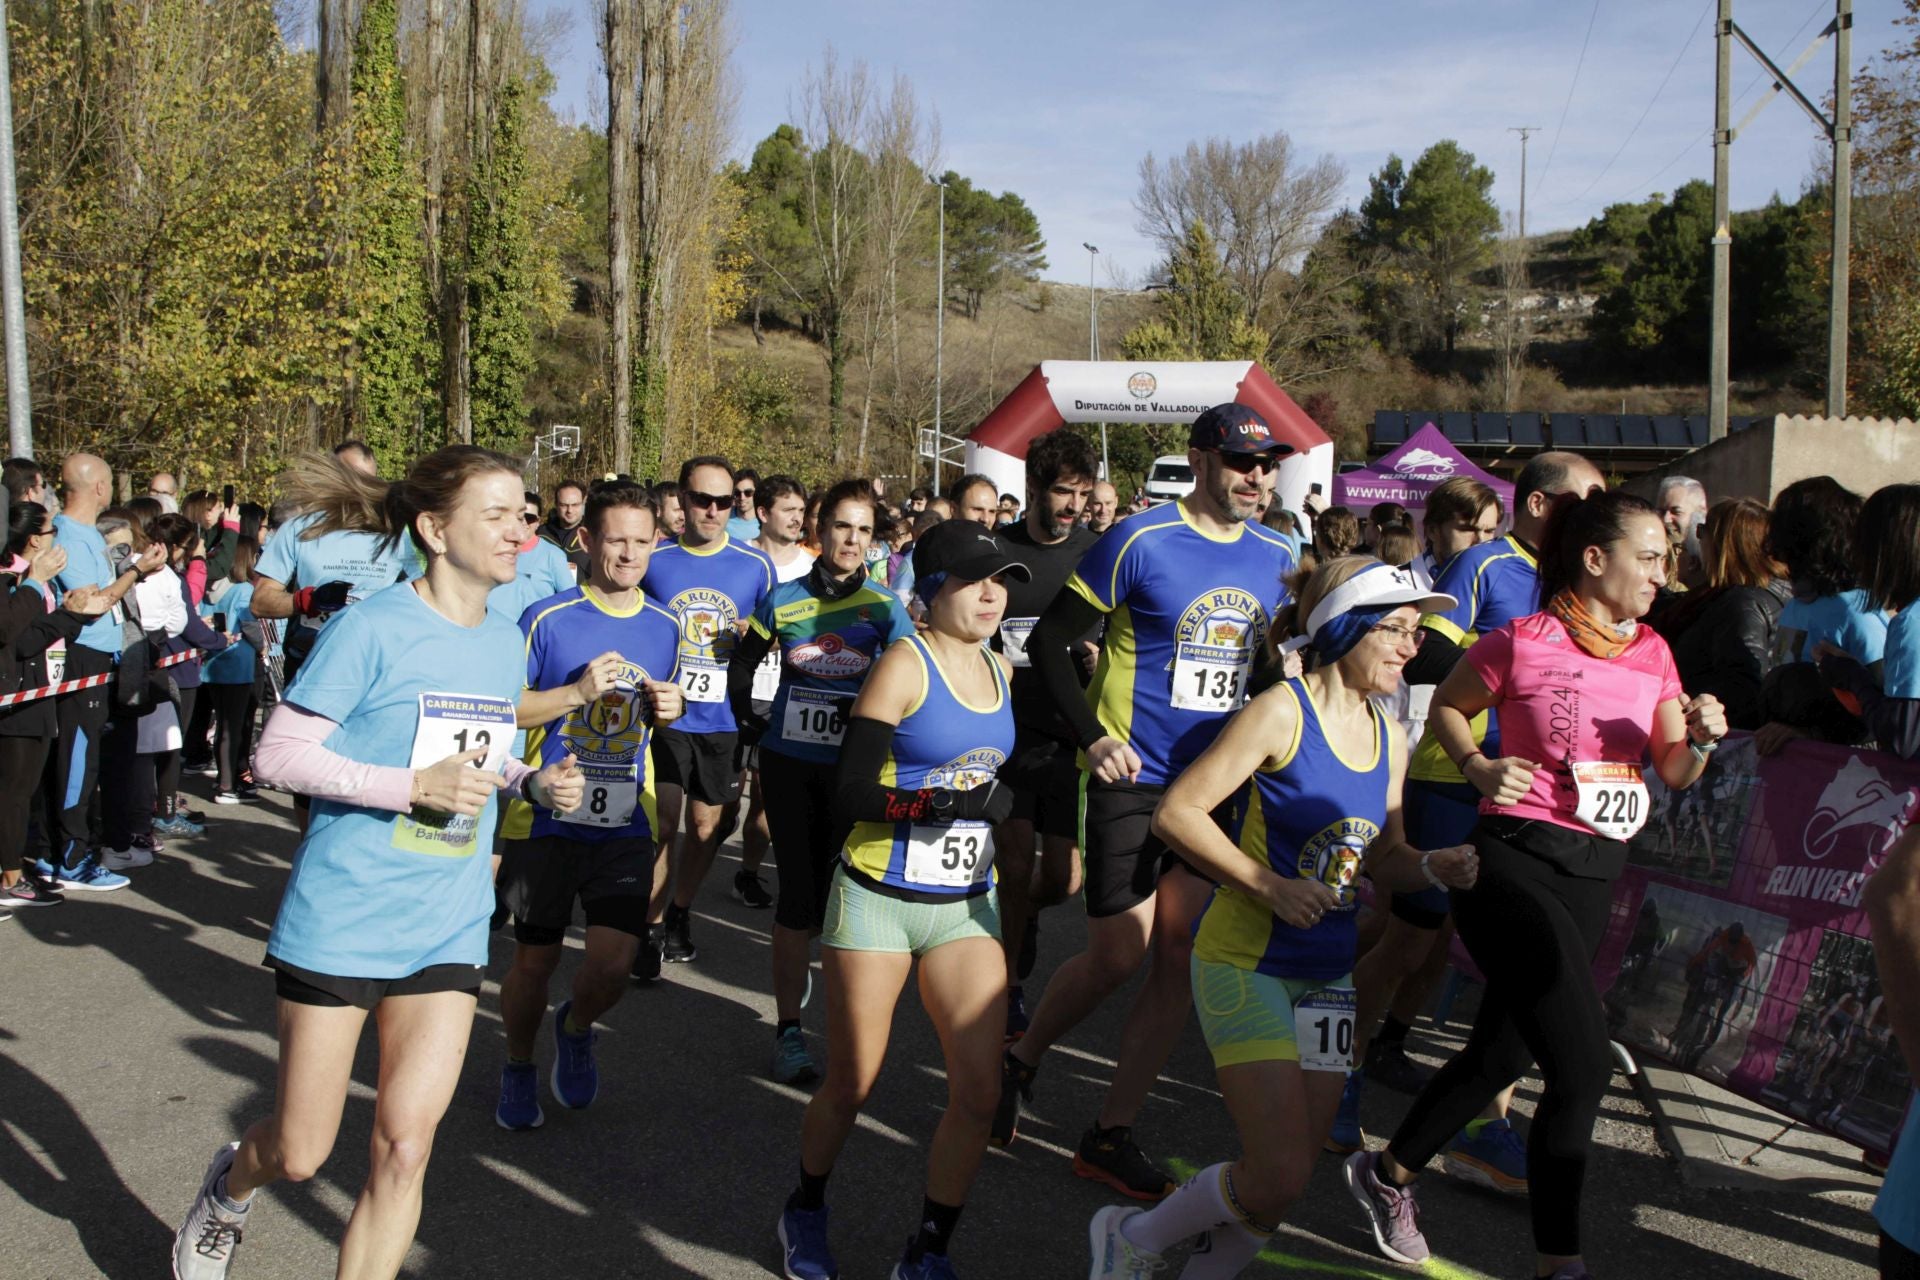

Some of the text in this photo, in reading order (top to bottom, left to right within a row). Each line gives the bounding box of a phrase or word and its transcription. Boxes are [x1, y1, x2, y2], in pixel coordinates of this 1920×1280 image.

[1135, 403, 1147, 412] DE
[780, 606, 806, 619] luanvi
[1182, 646, 1224, 659] CARRERA
[686, 671, 711, 693] 73
[1194, 668, 1240, 700] 135
[1538, 670, 1571, 678] LABORAL
[426, 699, 513, 715] CARRERA POPULAR
[799, 707, 844, 736] 106
[1549, 687, 1572, 744] 2024
[590, 786, 608, 815] 8
[1593, 789, 1639, 824] 220
[941, 835, 978, 871] 53
[1301, 829, 1337, 870] BEER
